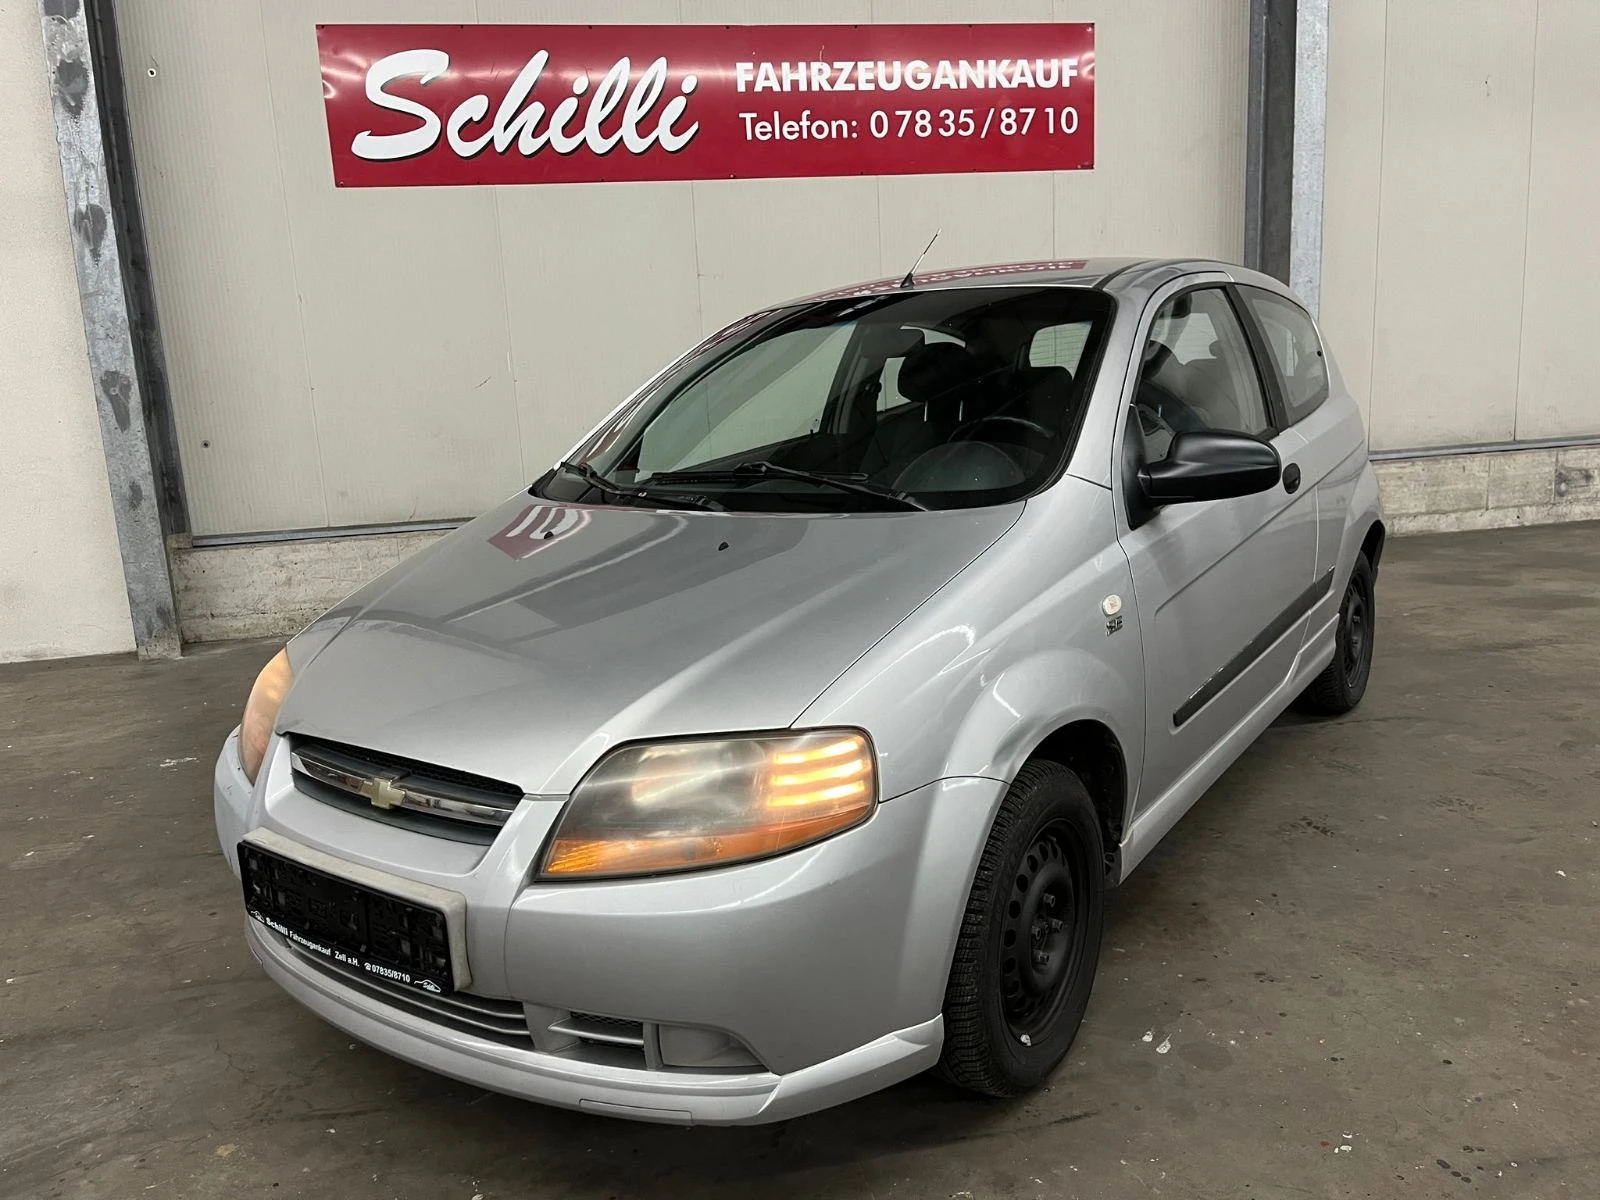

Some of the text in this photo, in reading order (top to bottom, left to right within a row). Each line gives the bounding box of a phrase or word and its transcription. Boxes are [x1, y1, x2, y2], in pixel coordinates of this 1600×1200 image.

[735, 59, 1080, 93] FAHRZEUGANKAUF
[351, 49, 699, 160] Schilli
[739, 109, 858, 141] Telefon:
[371, 964, 411, 983] 07835/8710
